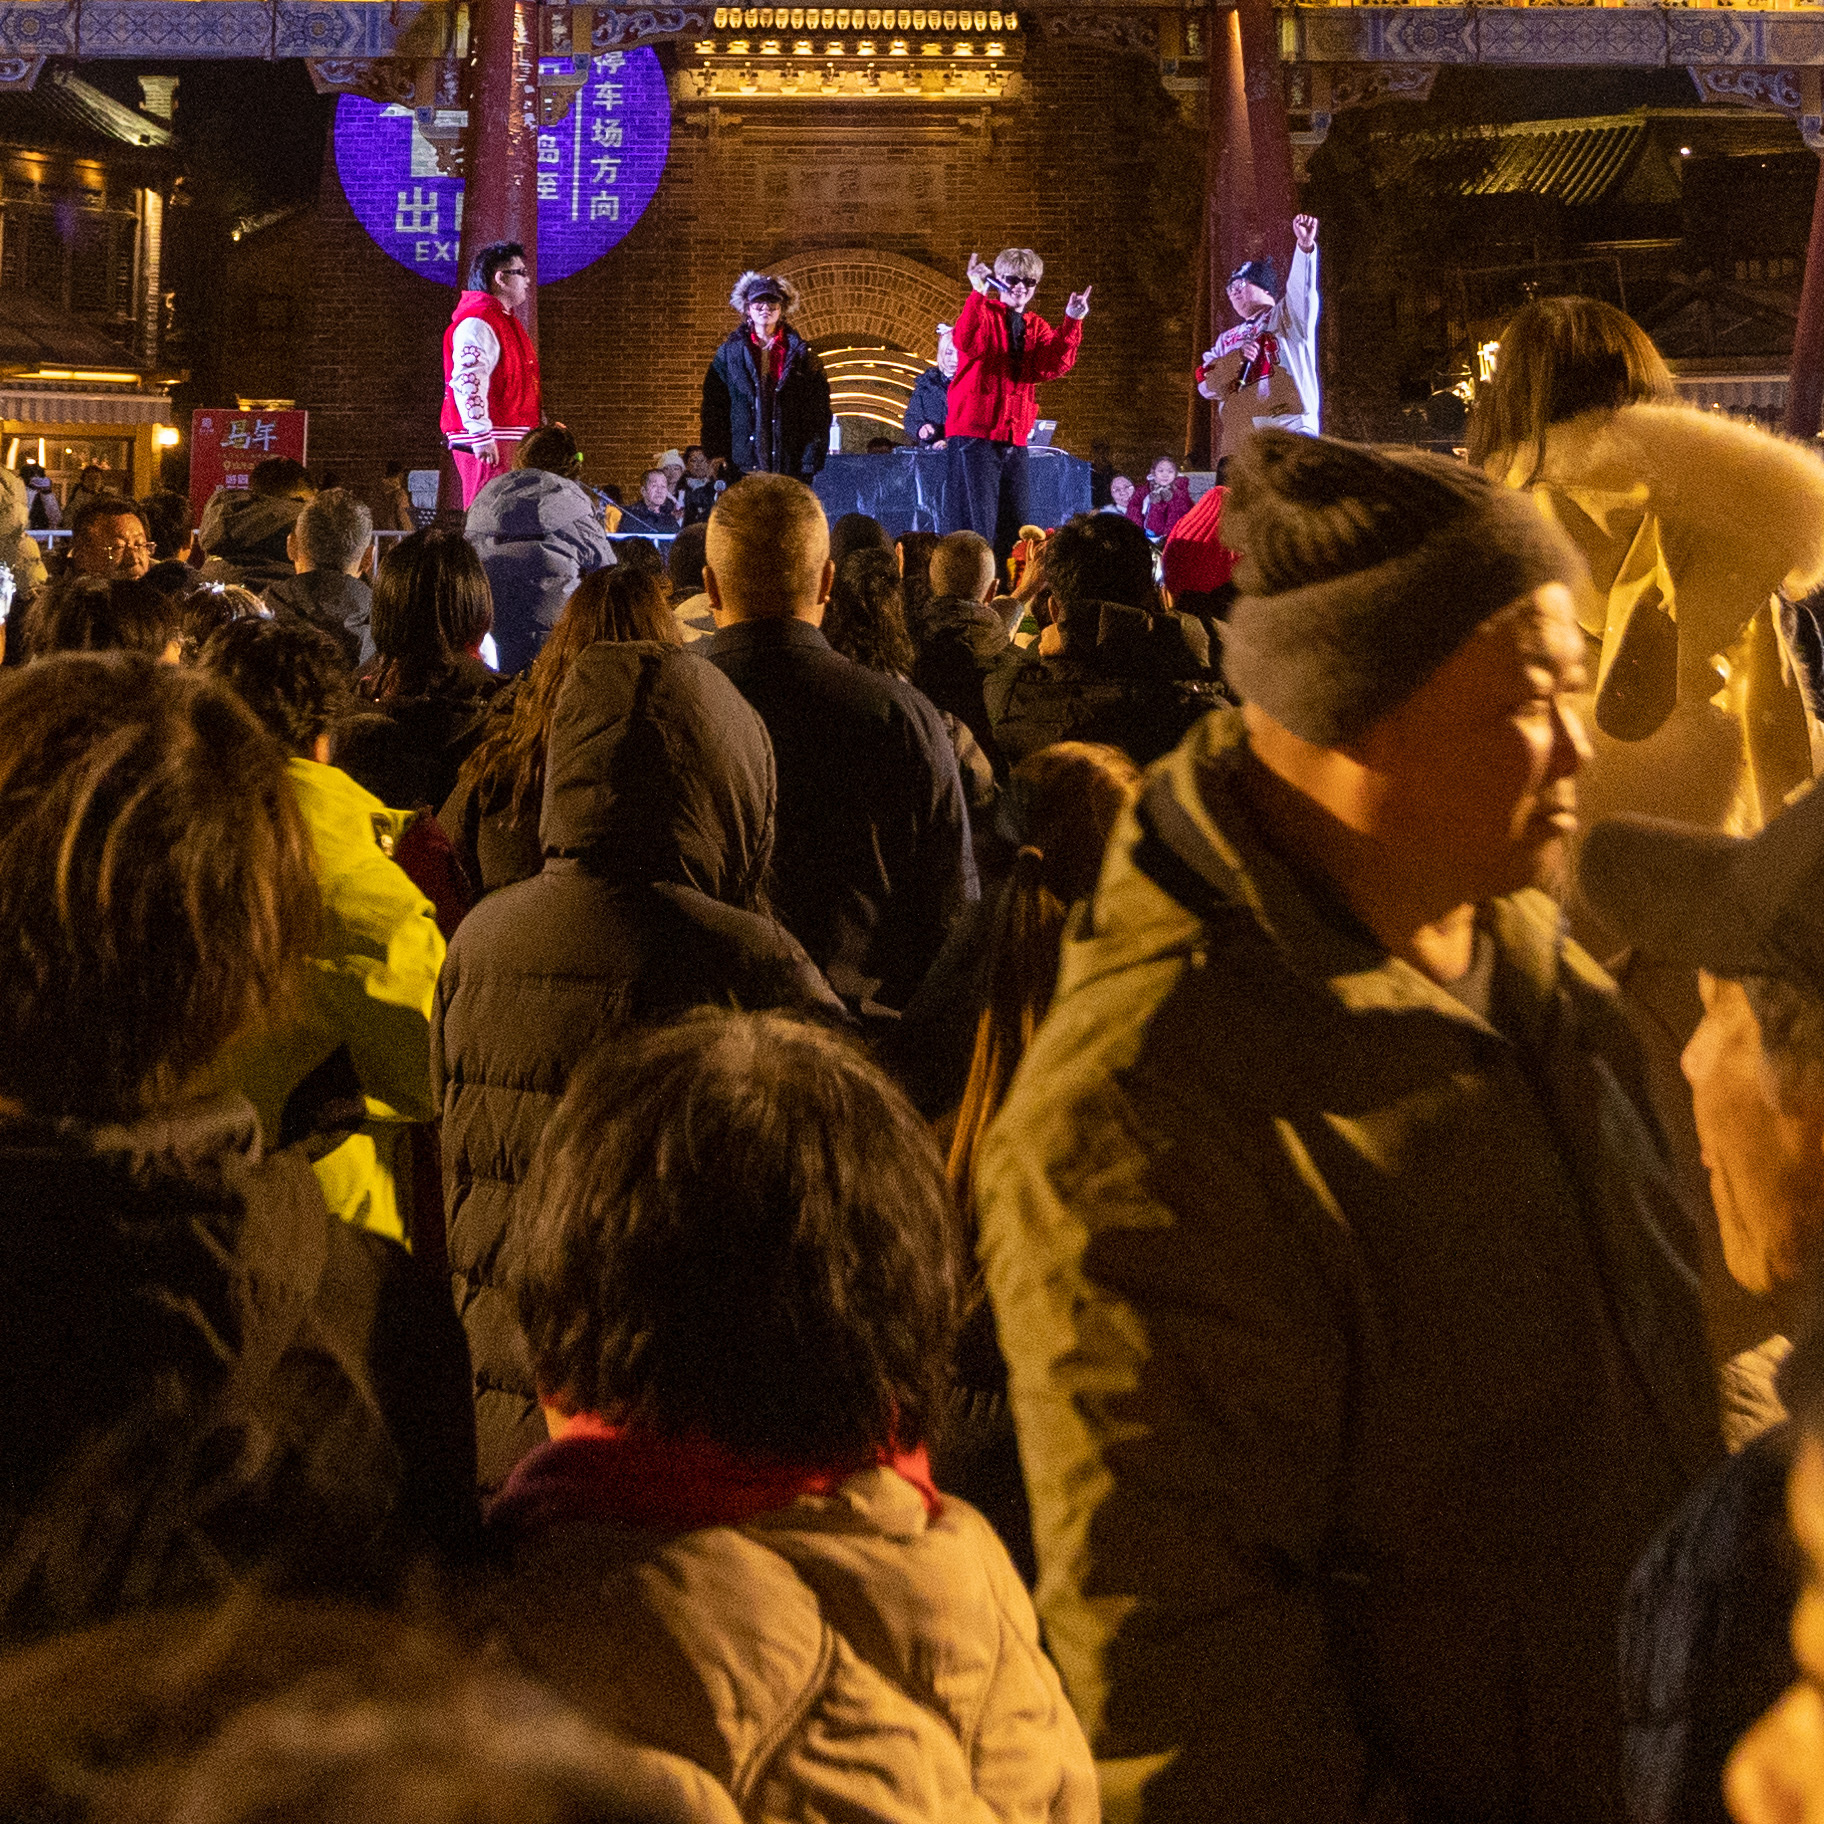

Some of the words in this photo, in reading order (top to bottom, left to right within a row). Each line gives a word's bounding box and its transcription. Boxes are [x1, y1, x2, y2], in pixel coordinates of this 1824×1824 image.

[590, 50, 626, 221] 停车场方向
[415, 240, 460, 262] EXI
